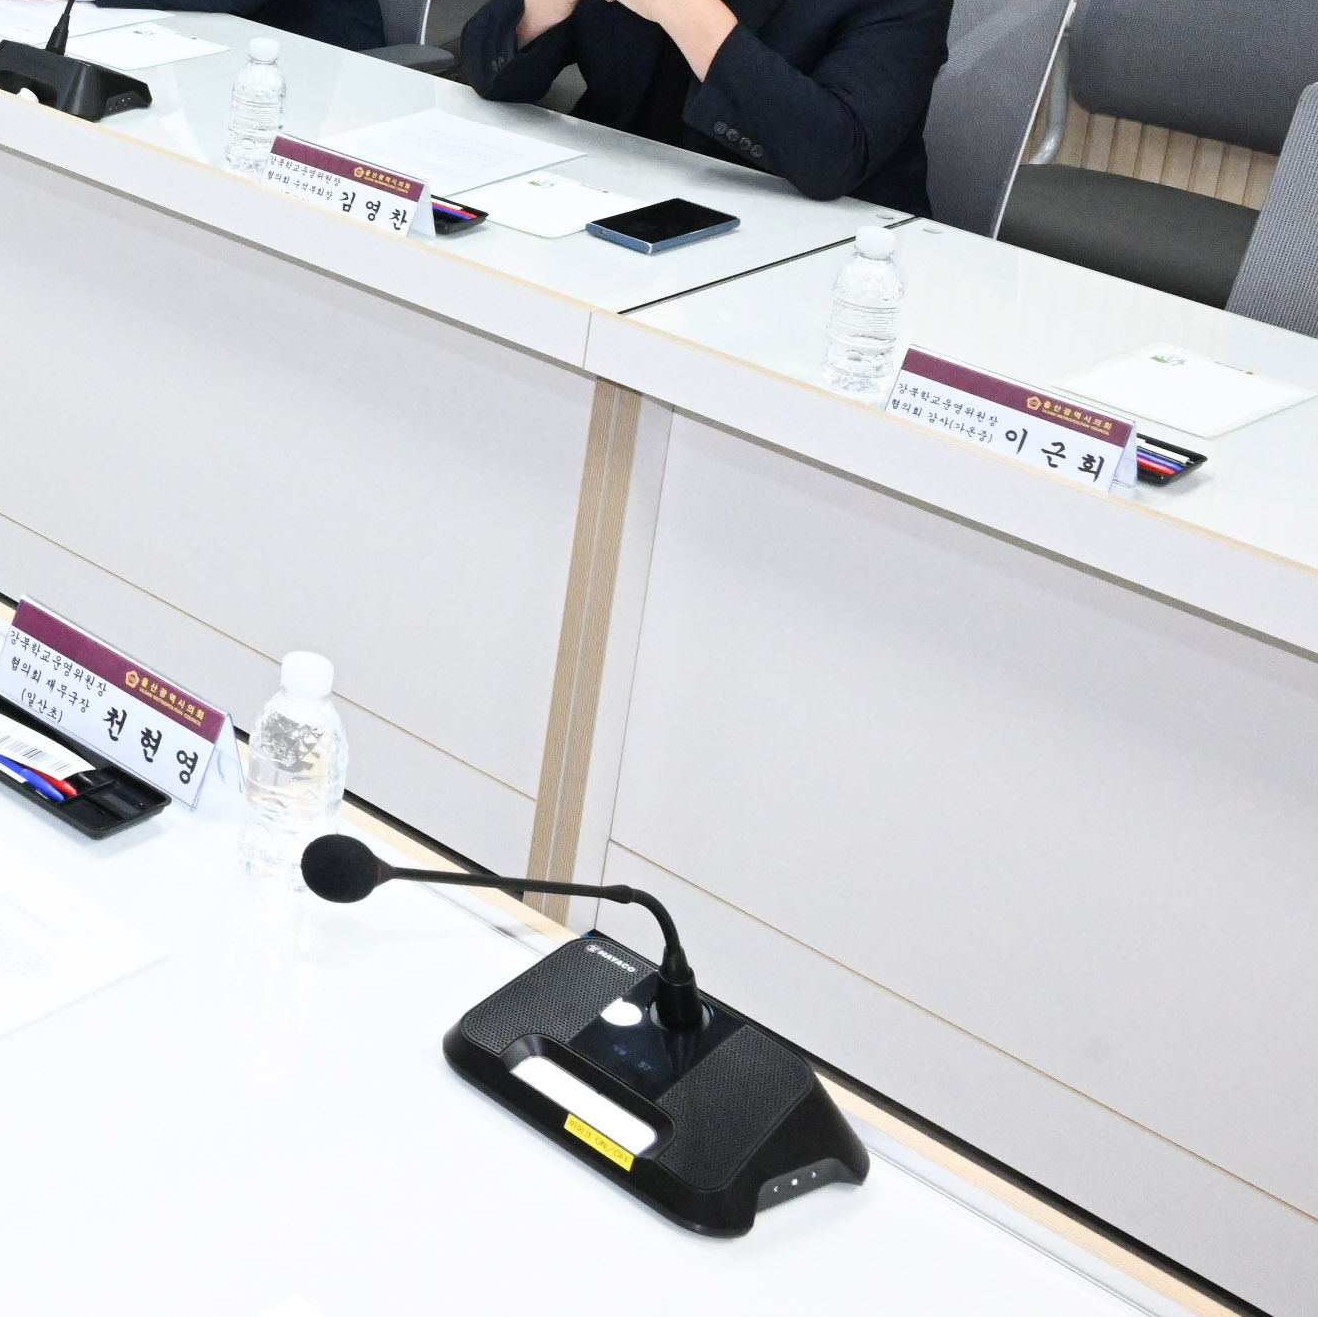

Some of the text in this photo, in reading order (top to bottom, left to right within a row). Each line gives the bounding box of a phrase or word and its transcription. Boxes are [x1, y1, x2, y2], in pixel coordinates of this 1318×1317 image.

[892, 399, 922, 418] 협의회
[899, 383, 999, 426] 강북학교운영위원장
[10, 630, 107, 697] 강북학교운영위원장
[11, 656, 90, 713] 협의회 재무국장
[142, 677, 205, 721] 울산광역시의회
